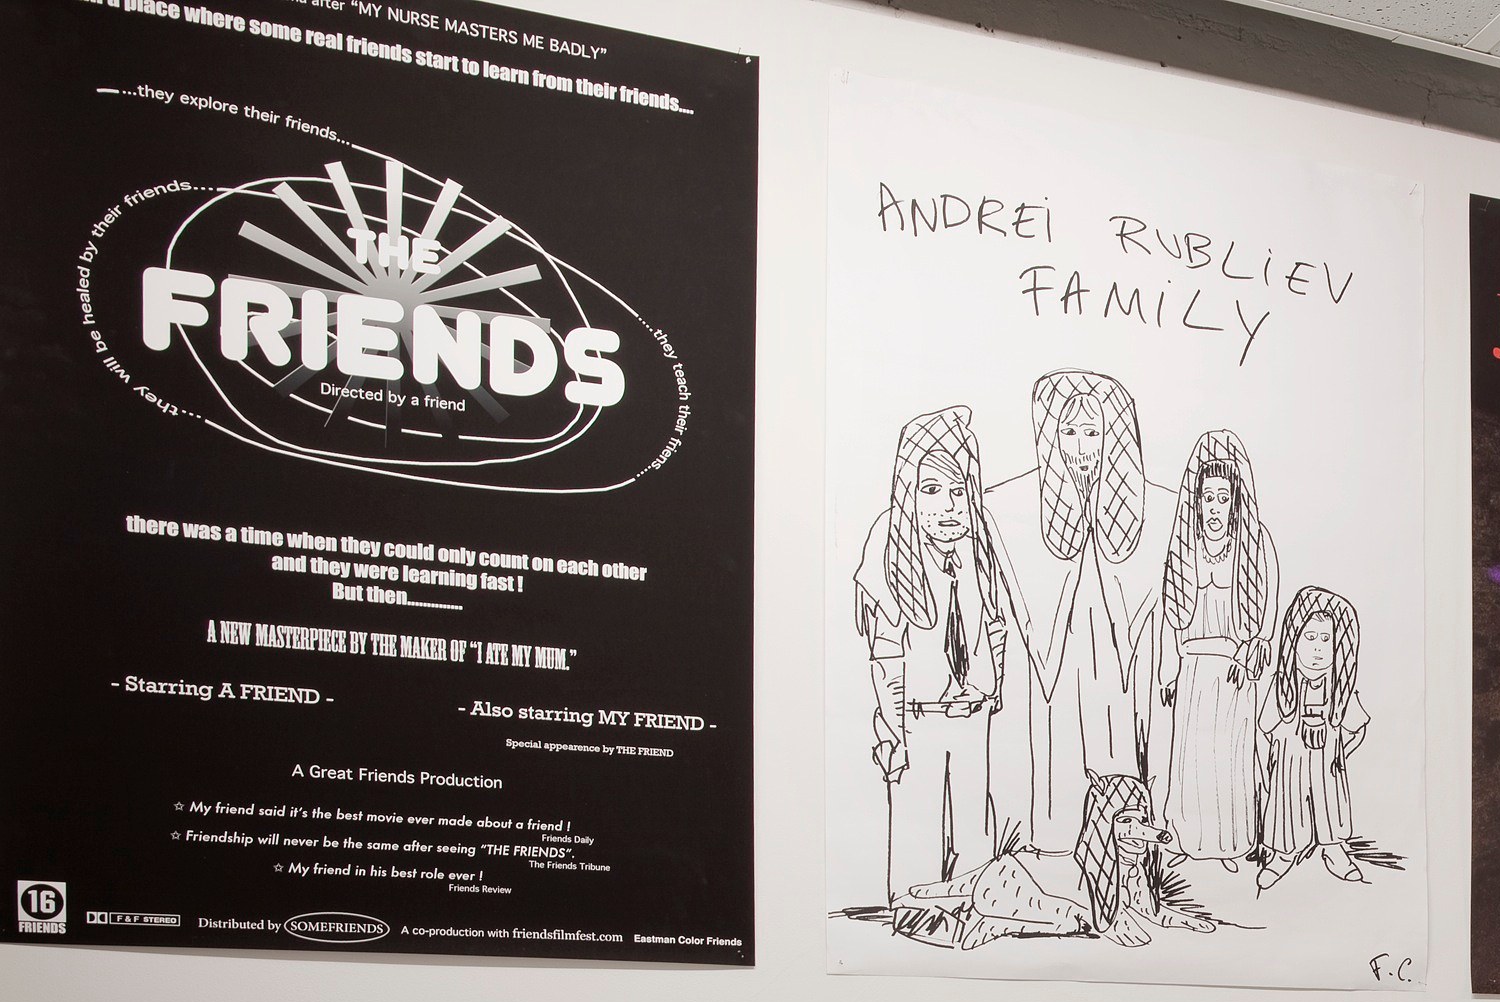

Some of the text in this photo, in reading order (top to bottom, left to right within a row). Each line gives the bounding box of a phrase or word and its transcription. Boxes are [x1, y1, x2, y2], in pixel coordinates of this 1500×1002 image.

[311, 0, 608, 60] after “MY NURSE MASTERS ME BADLY”
[179, 93, 239, 115] explore
[243, 106, 281, 124] their
[346, 228, 441, 275] THE
[142, 266, 626, 407] FRIENDS
[320, 381, 466, 412] Directed by a friend
[271, 554, 515, 593] and they were learning fast
[332, 581, 364, 602] But
[206, 619, 218, 643] A
[219, 620, 253, 646] NEW
[255, 622, 347, 654] MASTERPIECE
[349, 630, 369, 655] BY
[370, 632, 398, 658] THE
[399, 634, 448, 662] MAKER
[449, 639, 468, 663] OF
[484, 642, 509, 666] ATE
[511, 643, 533, 668] MY
[125, 675, 321, 705] Starring A FRIEND
[469, 700, 705, 731] Also starring MY FRIEND
[505, 738, 674, 758] Special appearence by THE FRIEND
[291, 763, 503, 789] A Great Friends Production
[189, 800, 212, 816] My
[215, 801, 255, 816] friend
[258, 804, 286, 817] said
[311, 806, 333, 820] the
[336, 807, 364, 821] best
[366, 812, 404, 824] movie
[407, 816, 435, 825] ever
[437, 814, 473, 827] made
[476, 815, 513, 829] about
[515, 821, 524, 830] a
[527, 818, 564, 832] friend
[185, 829, 254, 847] Friendship
[257, 833, 280, 846] will
[283, 838, 320, 847] never
[322, 835, 340, 848] be
[342, 836, 363, 850] the
[366, 842, 400, 851] same
[402, 839, 434, 853] after
[436, 842, 476, 858] seeing
[541, 833, 595, 846] Friends Daily
[287, 862, 476, 882] My friend in his best role ever
[528, 859, 611, 872] The Friends Tribune
[448, 883, 512, 894] Friends Review
[28, 890, 56, 913] 16
[18, 921, 66, 935] FRIENDS
[117, 915, 123, 923] F
[125, 915, 132, 923] &
[143, 916, 177, 924] STEREO
[198, 917, 384, 934] Distributed by SOMEFRIENDS
[400, 925, 624, 943] A co-production with friendsfilmfest.com
[633, 933, 743, 947] Eastman Color Friends
